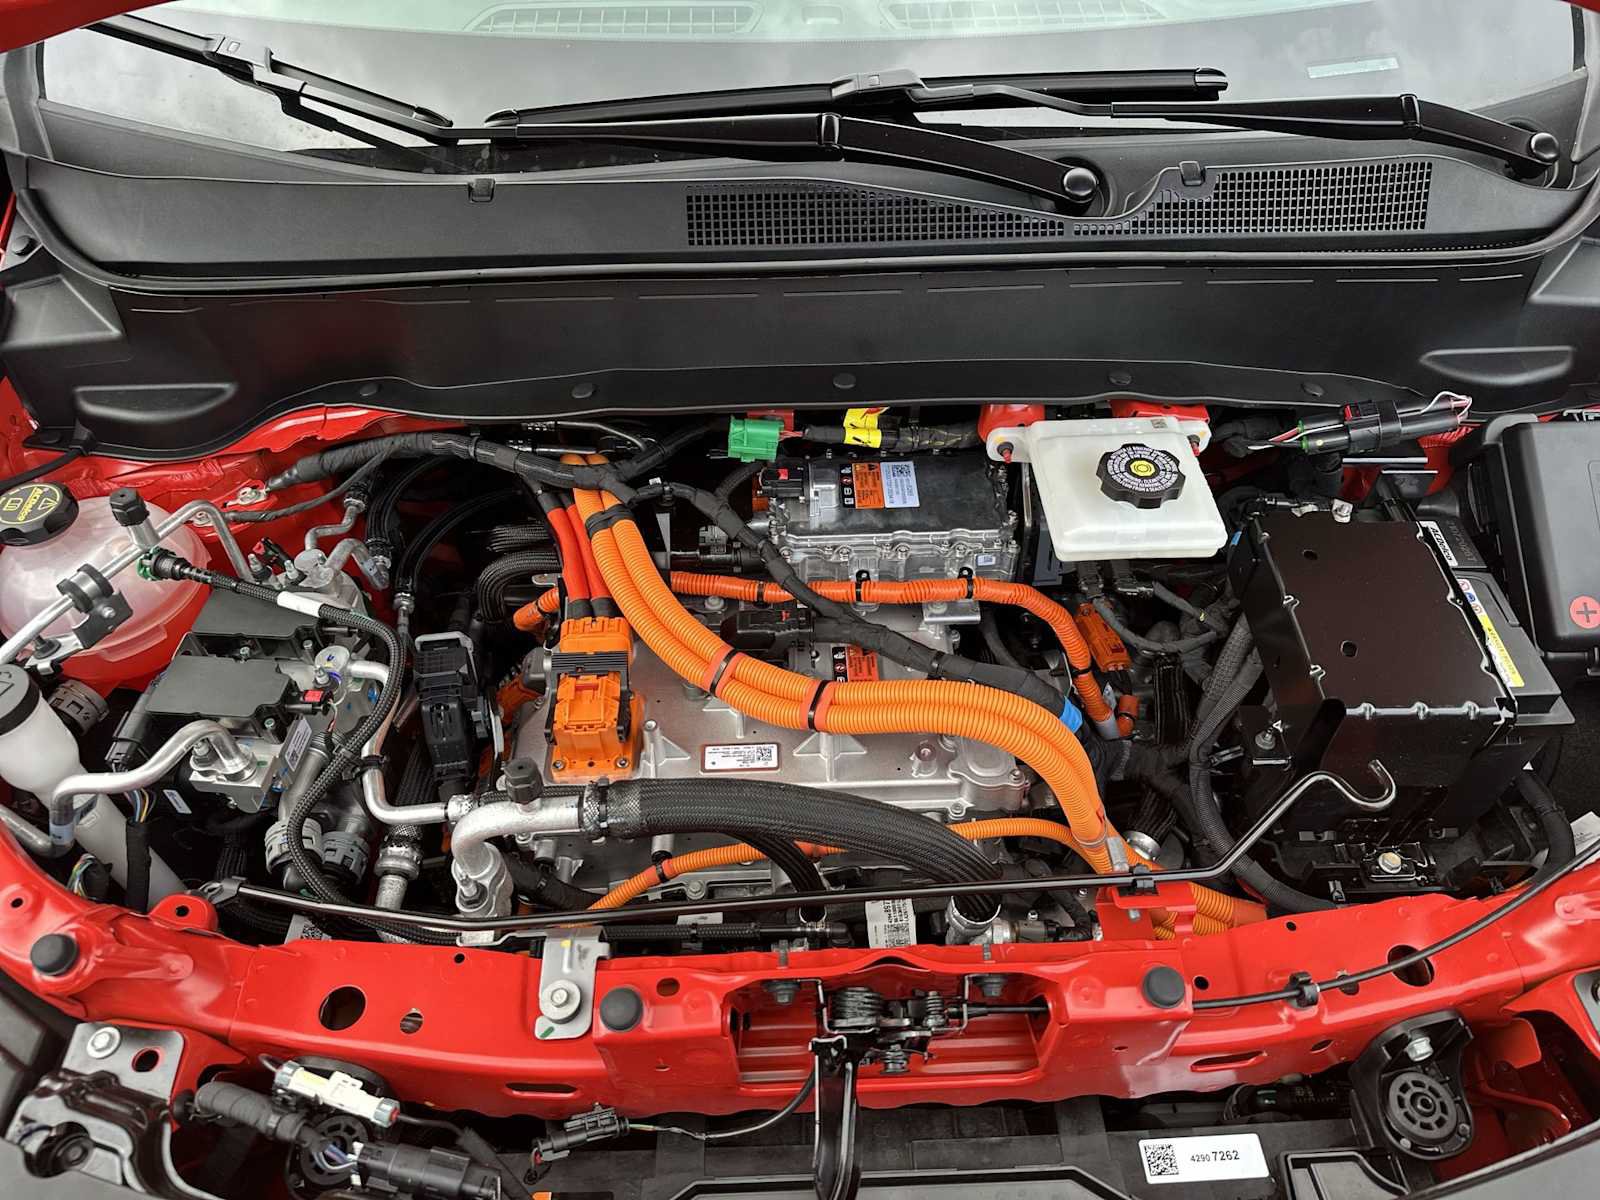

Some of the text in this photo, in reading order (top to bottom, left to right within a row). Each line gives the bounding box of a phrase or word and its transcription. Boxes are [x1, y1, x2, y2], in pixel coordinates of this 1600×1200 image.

[1430, 527, 1453, 561] ACDelco
[1191, 1150, 1240, 1163] 4290 7262
